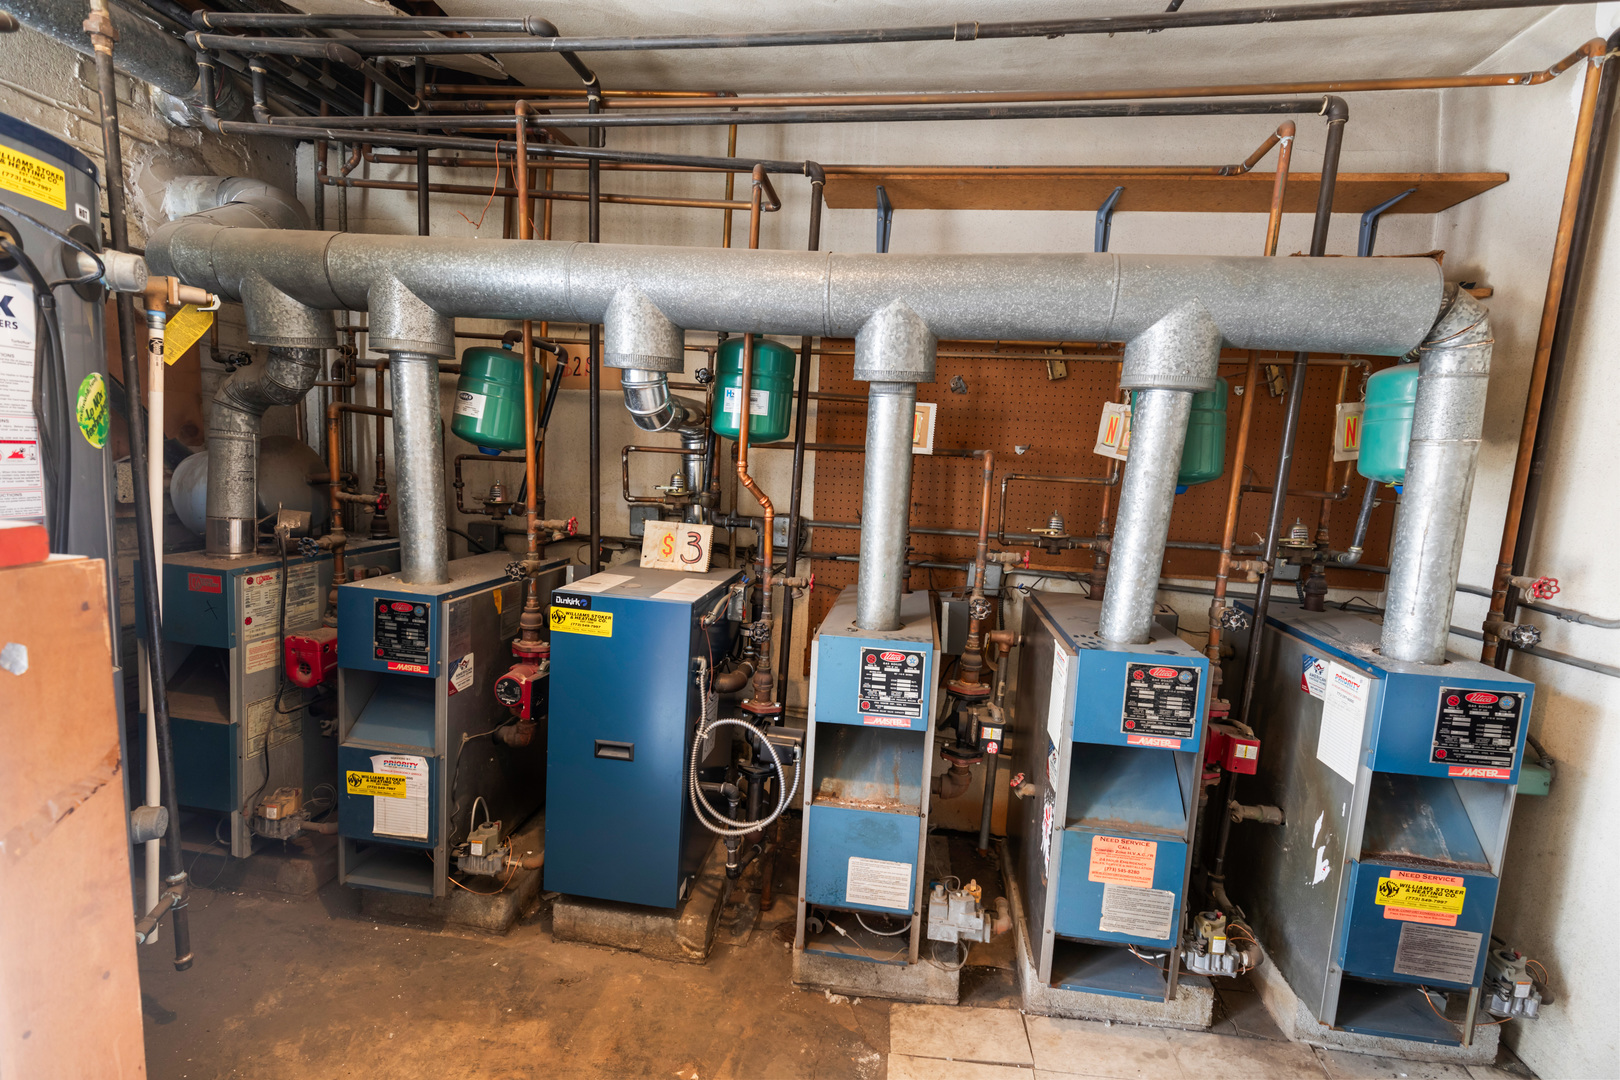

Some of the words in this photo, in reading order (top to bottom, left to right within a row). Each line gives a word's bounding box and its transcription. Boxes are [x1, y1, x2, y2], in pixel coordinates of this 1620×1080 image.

[2, 170, 22, 182] (773)
[8, 161, 45, 180] HEATING
[47, 176, 59, 186] CO.
[36, 166, 64, 182] STOKER
[555, 595, 581, 607] Dunkirk
[396, 663, 422, 672] MASTER
[1334, 673, 1361, 691] PRIORITY
[1469, 693, 1493, 703] Utica
[873, 717, 902, 725] MASTER
[1138, 737, 1171, 746] MASTER
[383, 759, 419, 769] PRIORITY
[1460, 768, 1499, 777] MASTER
[1100, 836, 1120, 844] NEED
[1121, 838, 1150, 847] SERVICE
[1120, 859, 1147, 867] EMERGENCY
[1398, 871, 1421, 879] NEED
[1422, 874, 1456, 883] SERVICE
[1399, 882, 1434, 892] WILLIAMS
[1435, 887, 1464, 895] STOKER
[1411, 889, 1443, 898] HEATING
